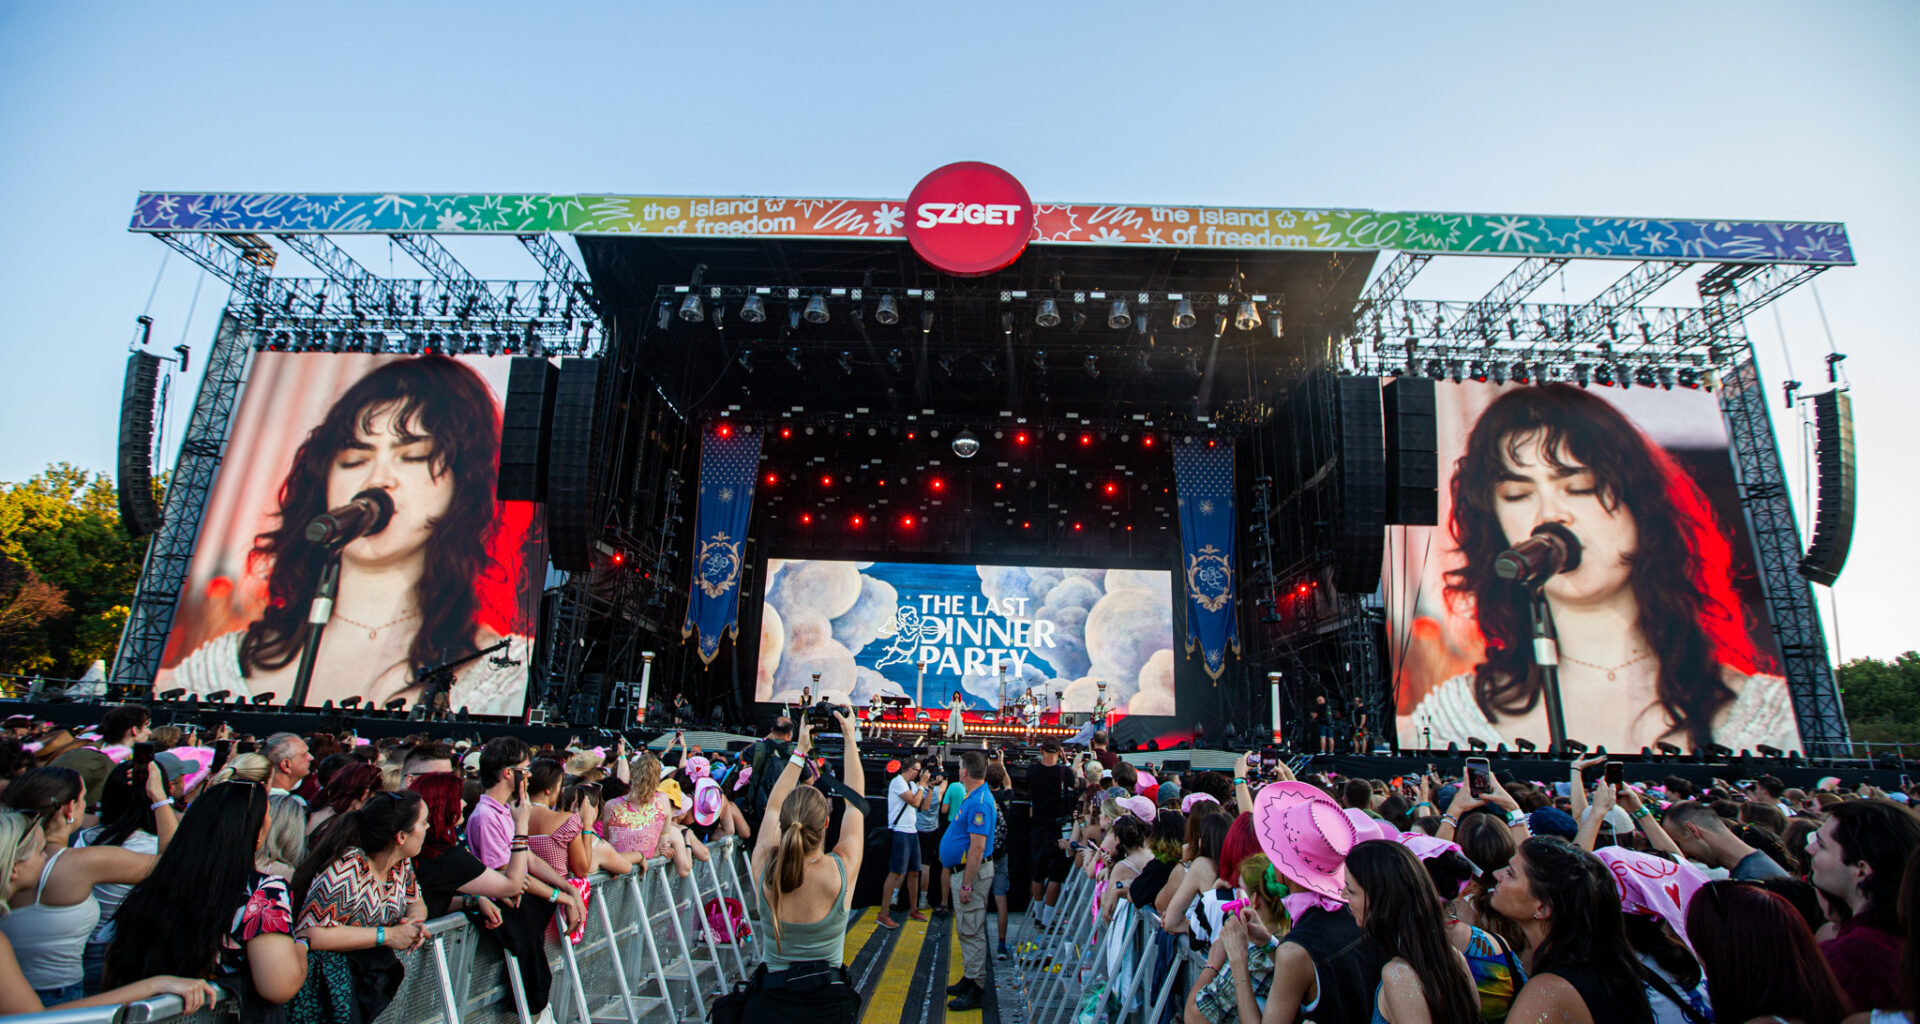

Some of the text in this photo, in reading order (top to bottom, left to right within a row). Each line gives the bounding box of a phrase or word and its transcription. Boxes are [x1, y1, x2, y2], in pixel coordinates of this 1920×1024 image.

[643, 199, 758, 221] the island
[1150, 207, 1269, 227] the island
[663, 216, 796, 234] of freedom
[1172, 225, 1308, 248] of freedom
[918, 594, 1030, 617] THE LAST
[920, 615, 1056, 648] DINNER
[920, 645, 1029, 677] PARTY
